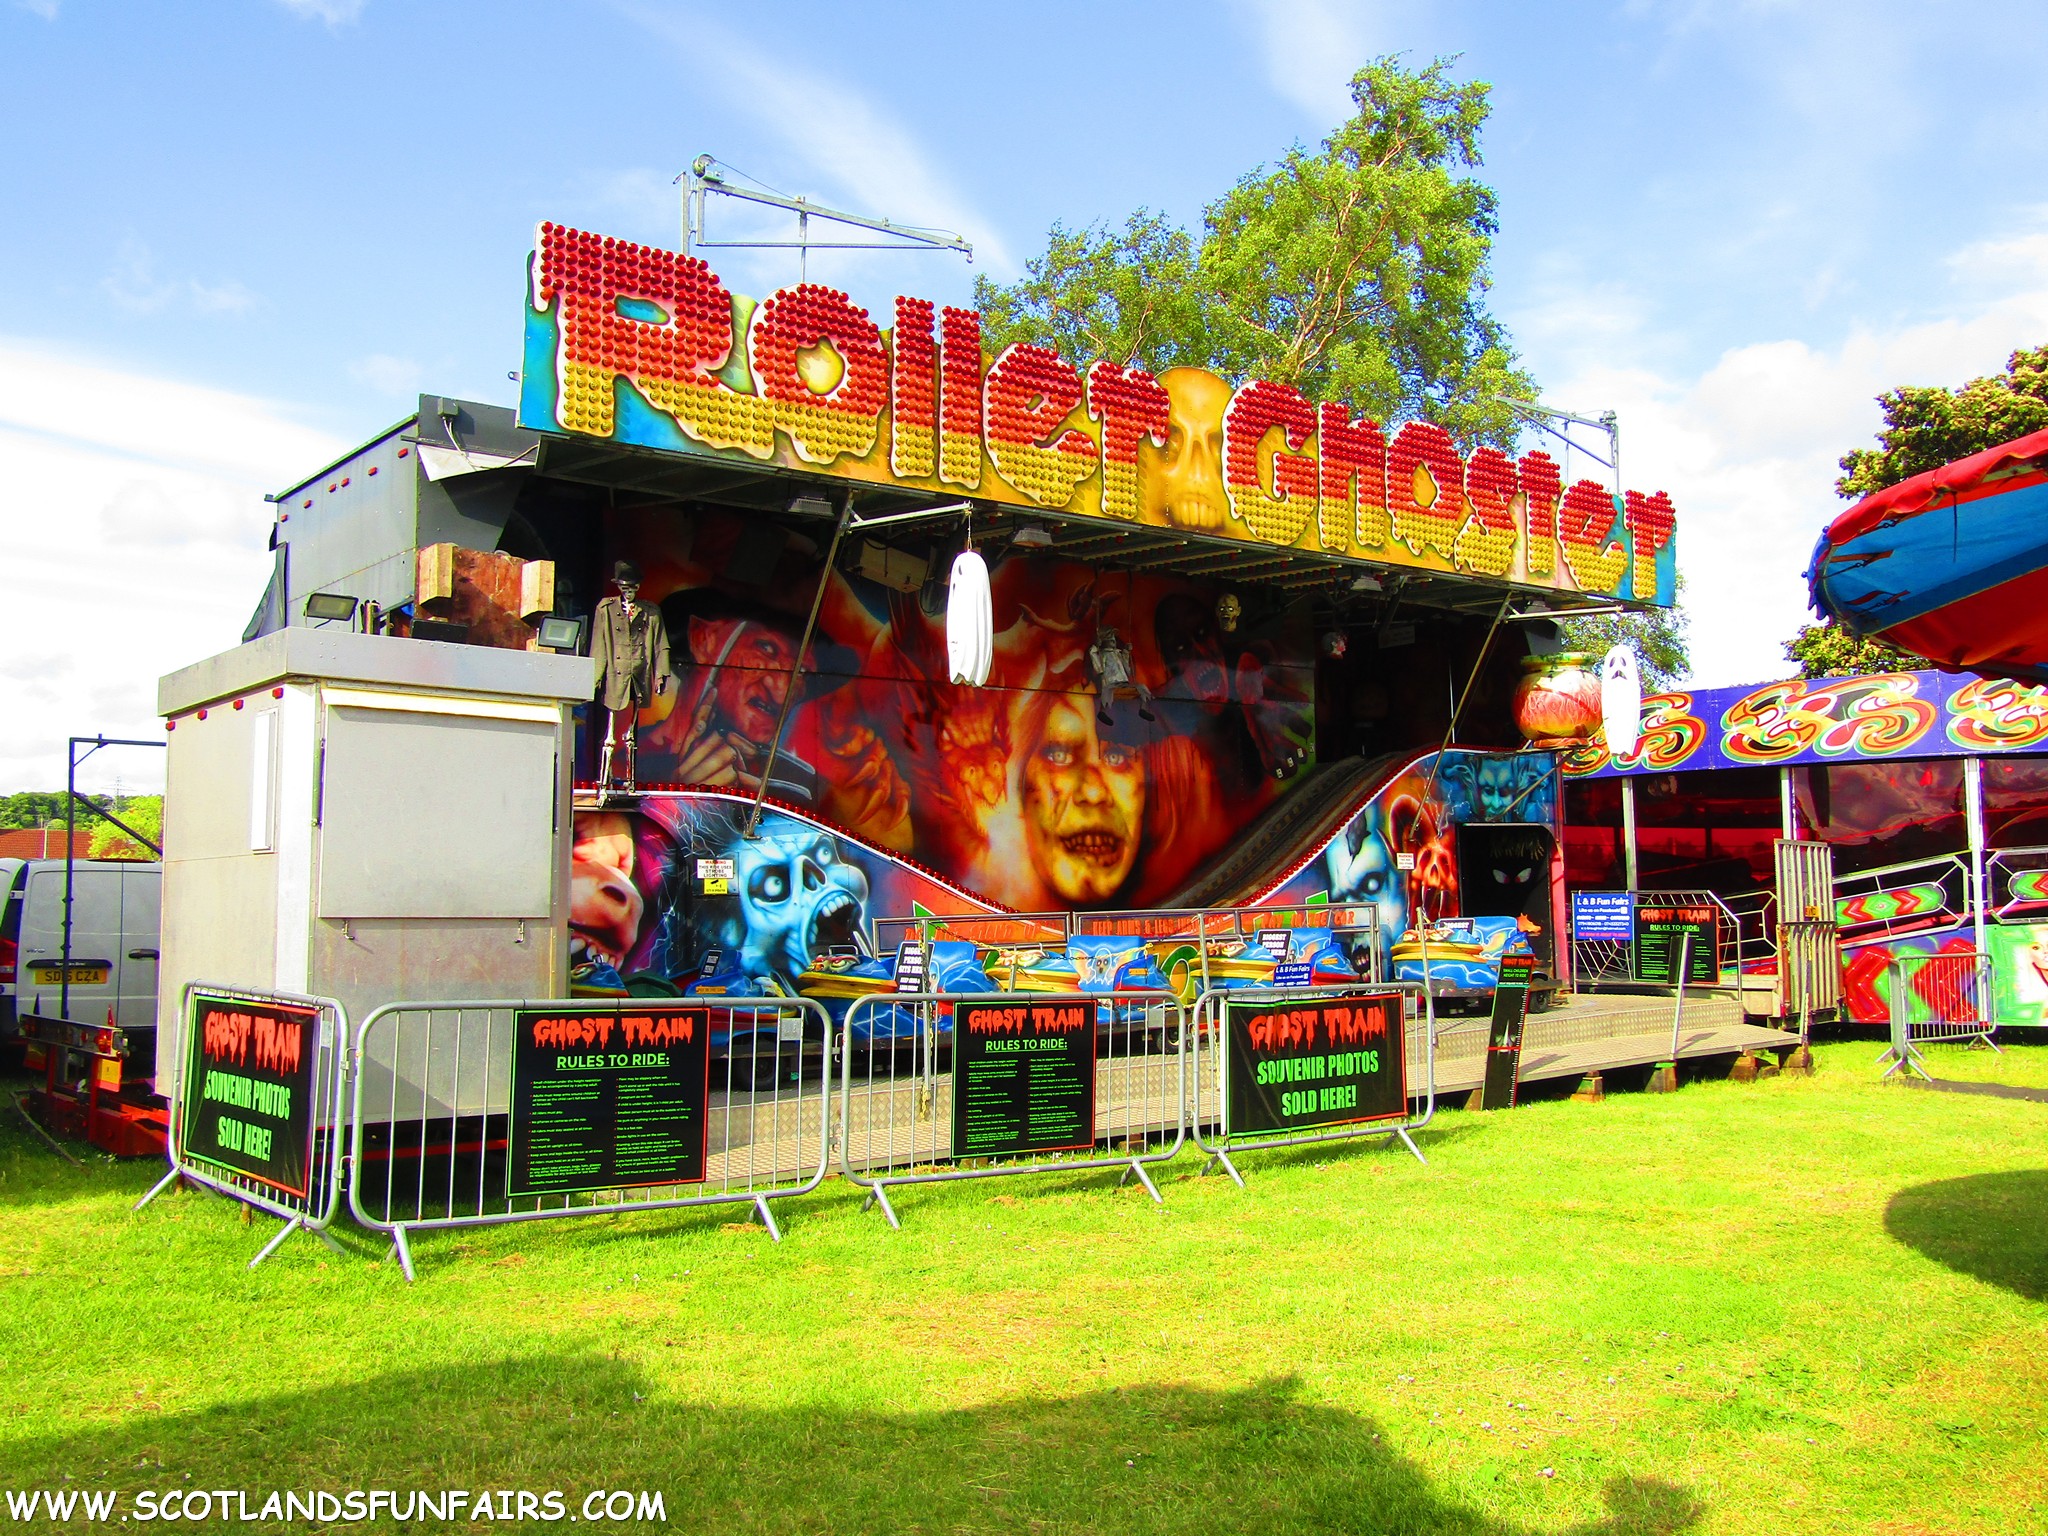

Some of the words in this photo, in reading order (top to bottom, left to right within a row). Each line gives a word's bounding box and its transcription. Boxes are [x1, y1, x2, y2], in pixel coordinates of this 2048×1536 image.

[534, 219, 1171, 519] Roller
[1222, 379, 1676, 600] Ghoster
[1577, 897, 1582, 905] L
[1582, 897, 1589, 905] &
[1590, 897, 1596, 905] B
[1596, 897, 1610, 905] Fun
[1611, 897, 1629, 905] Fairs
[1640, 909, 1674, 922] GHOST
[1677, 909, 1710, 923] TRAIN
[1092, 921, 1113, 936] KEEP
[1117, 920, 1140, 935] ARMS
[1334, 910, 1354, 926] CAR
[75, 970, 100, 982] CZA
[533, 1017, 614, 1050] GHOST
[621, 1017, 692, 1049] TRAIN
[968, 1009, 1027, 1036] GHOST
[1032, 1007, 1084, 1035] TRAIN
[1323, 1006, 1386, 1048] TRAIN
[205, 1011, 252, 1067] GHOST
[254, 1017, 301, 1077] TRAIN
[985, 1040, 1020, 1051] RULES
[1023, 1039, 1037, 1050] TO
[1040, 1038, 1068, 1049] RIDE:
[556, 1056, 604, 1069] RULES
[608, 1054, 628, 1067] TO
[632, 1053, 670, 1066] RIDE:
[1257, 1056, 1325, 1085] SOUVENIR
[1328, 1050, 1379, 1077] PHOTOS
[204, 1070, 252, 1108] SOUVENIR
[252, 1079, 291, 1120] PHOTOS
[1282, 1090, 1317, 1116] SOLD
[1320, 1085, 1357, 1112] HERE!
[217, 1116, 243, 1151] SOLD
[244, 1125, 272, 1162] HERE!
